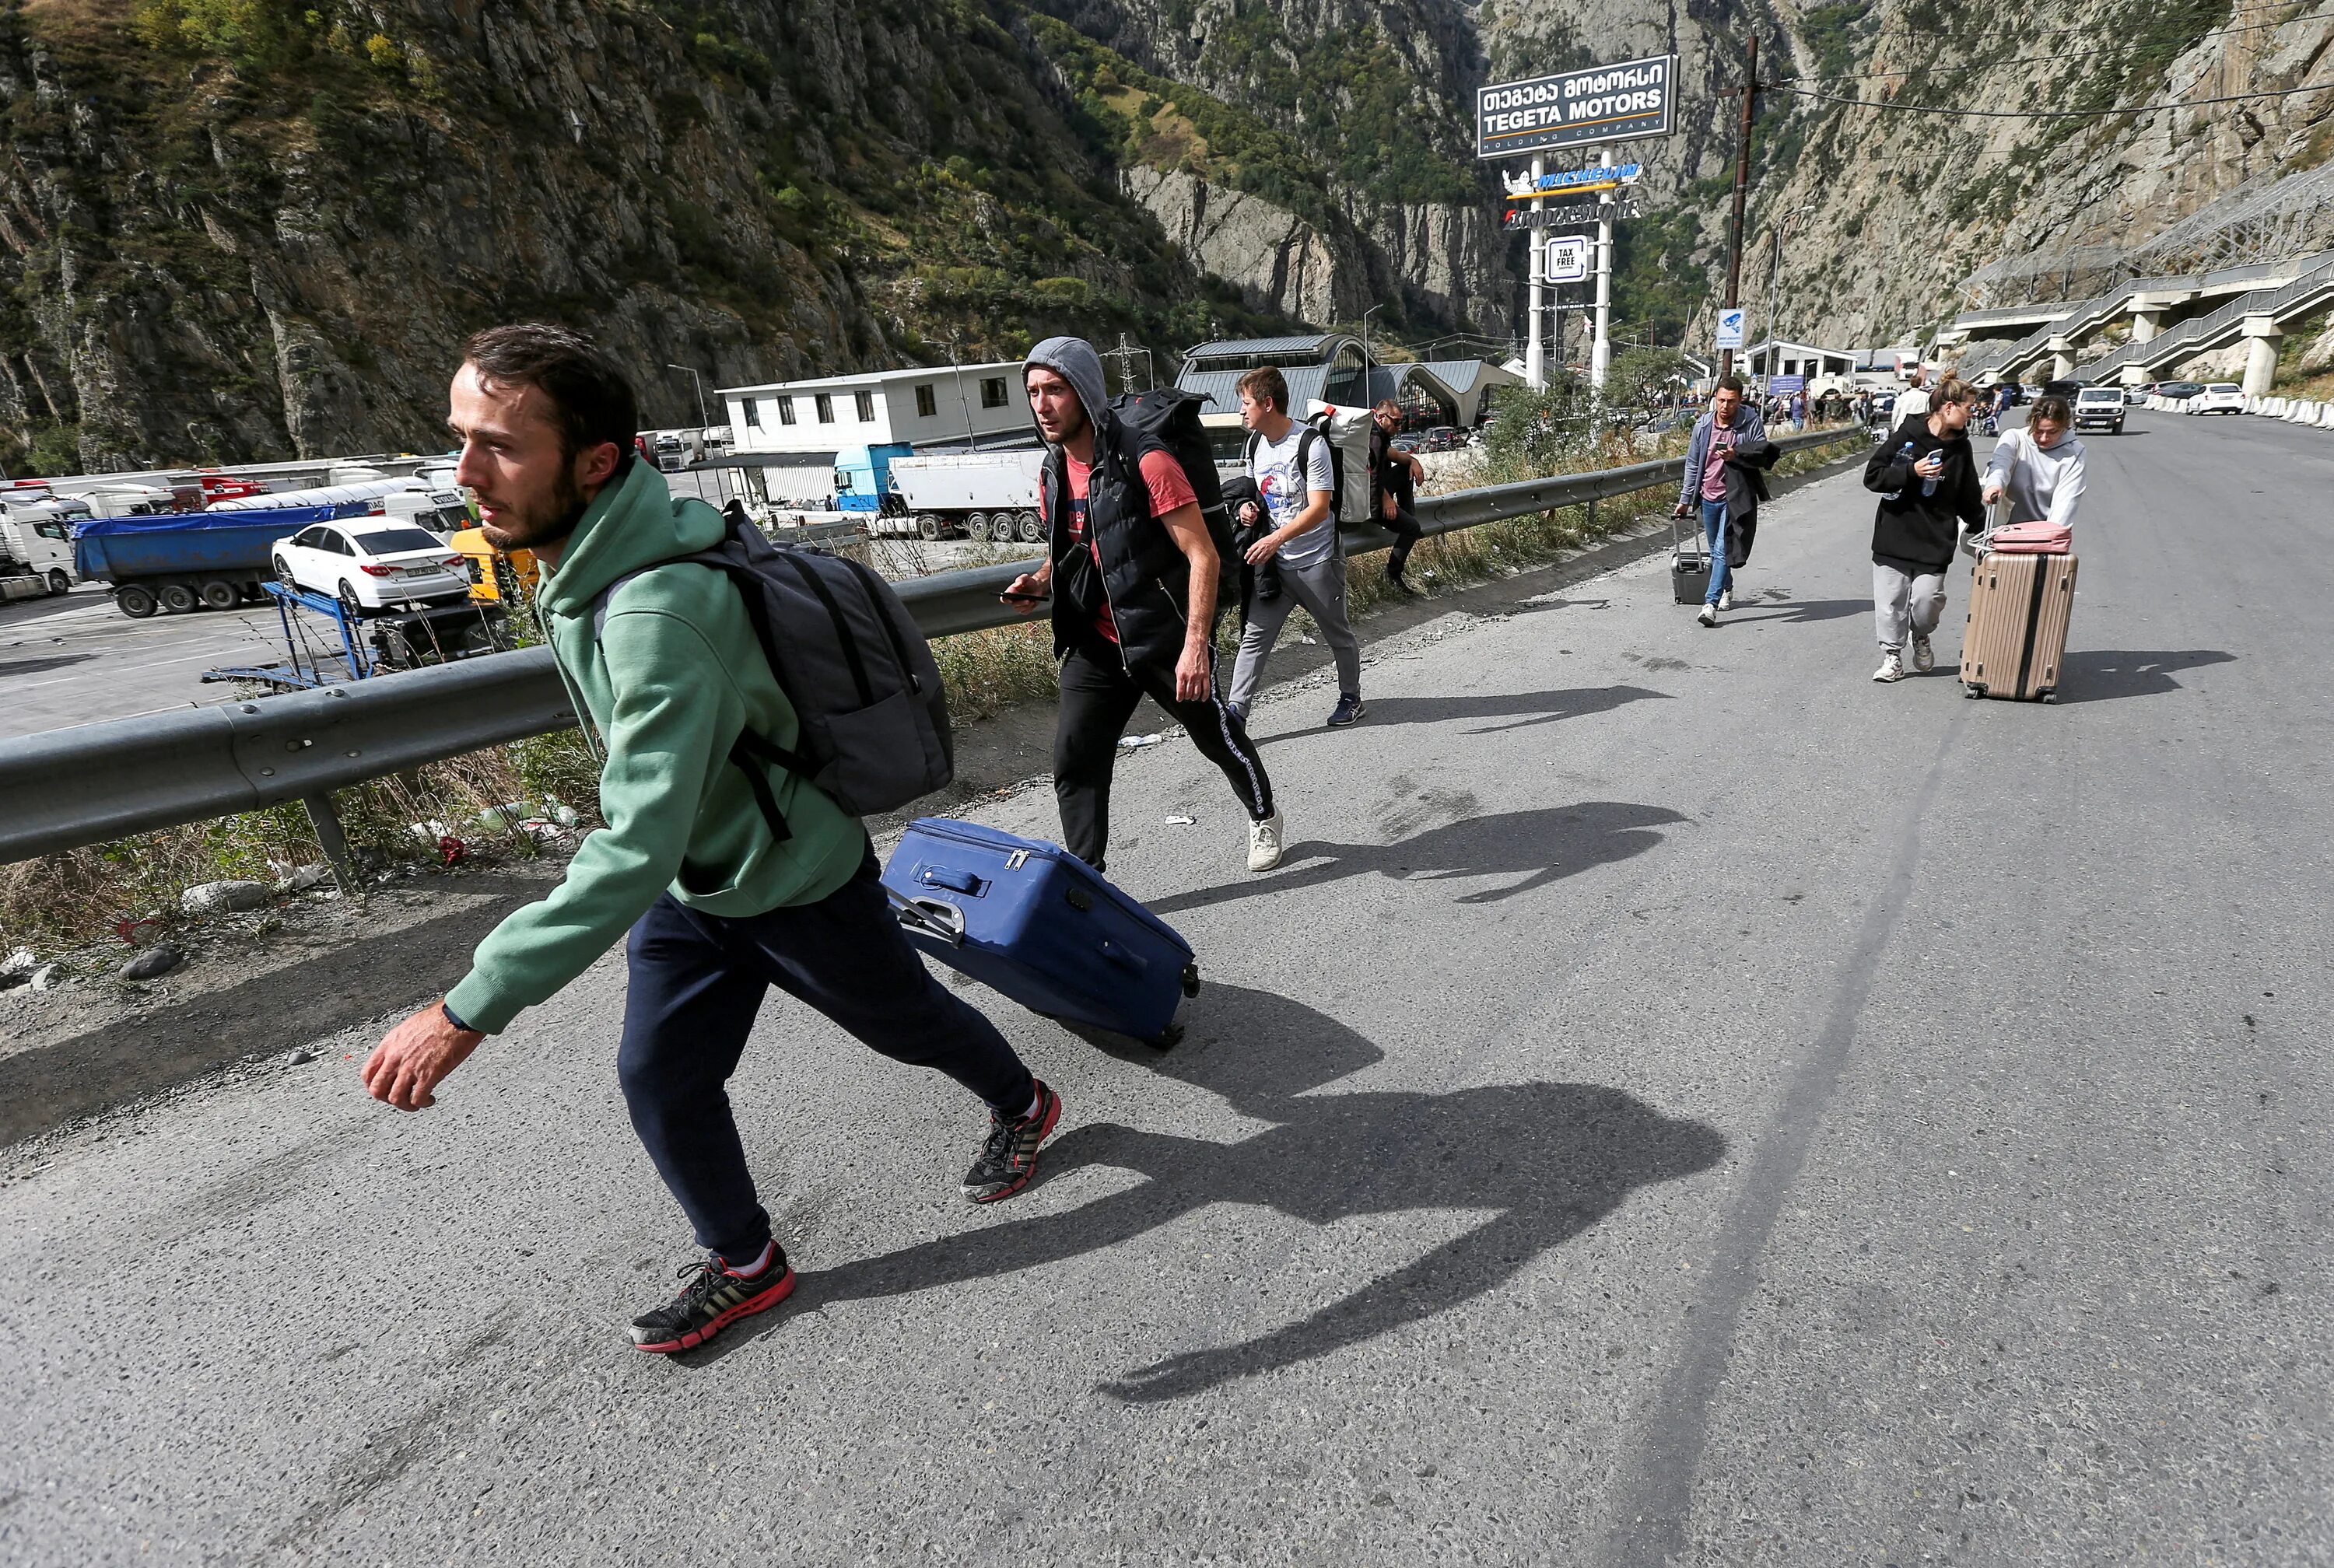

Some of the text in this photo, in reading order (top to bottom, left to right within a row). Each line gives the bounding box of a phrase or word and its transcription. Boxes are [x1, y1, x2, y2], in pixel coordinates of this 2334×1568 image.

[1483, 64, 1663, 112] თეგეტა მოტორსი
[1484, 89, 1663, 133] TEGETA MOTORS
[1484, 119, 1660, 150] HOLDING COMPANY
[1537, 163, 1640, 187] MICHELIN
[1557, 257, 1575, 266] FREE
[1559, 248, 1573, 257] TAX
[433, 494, 460, 504] VOLVO
